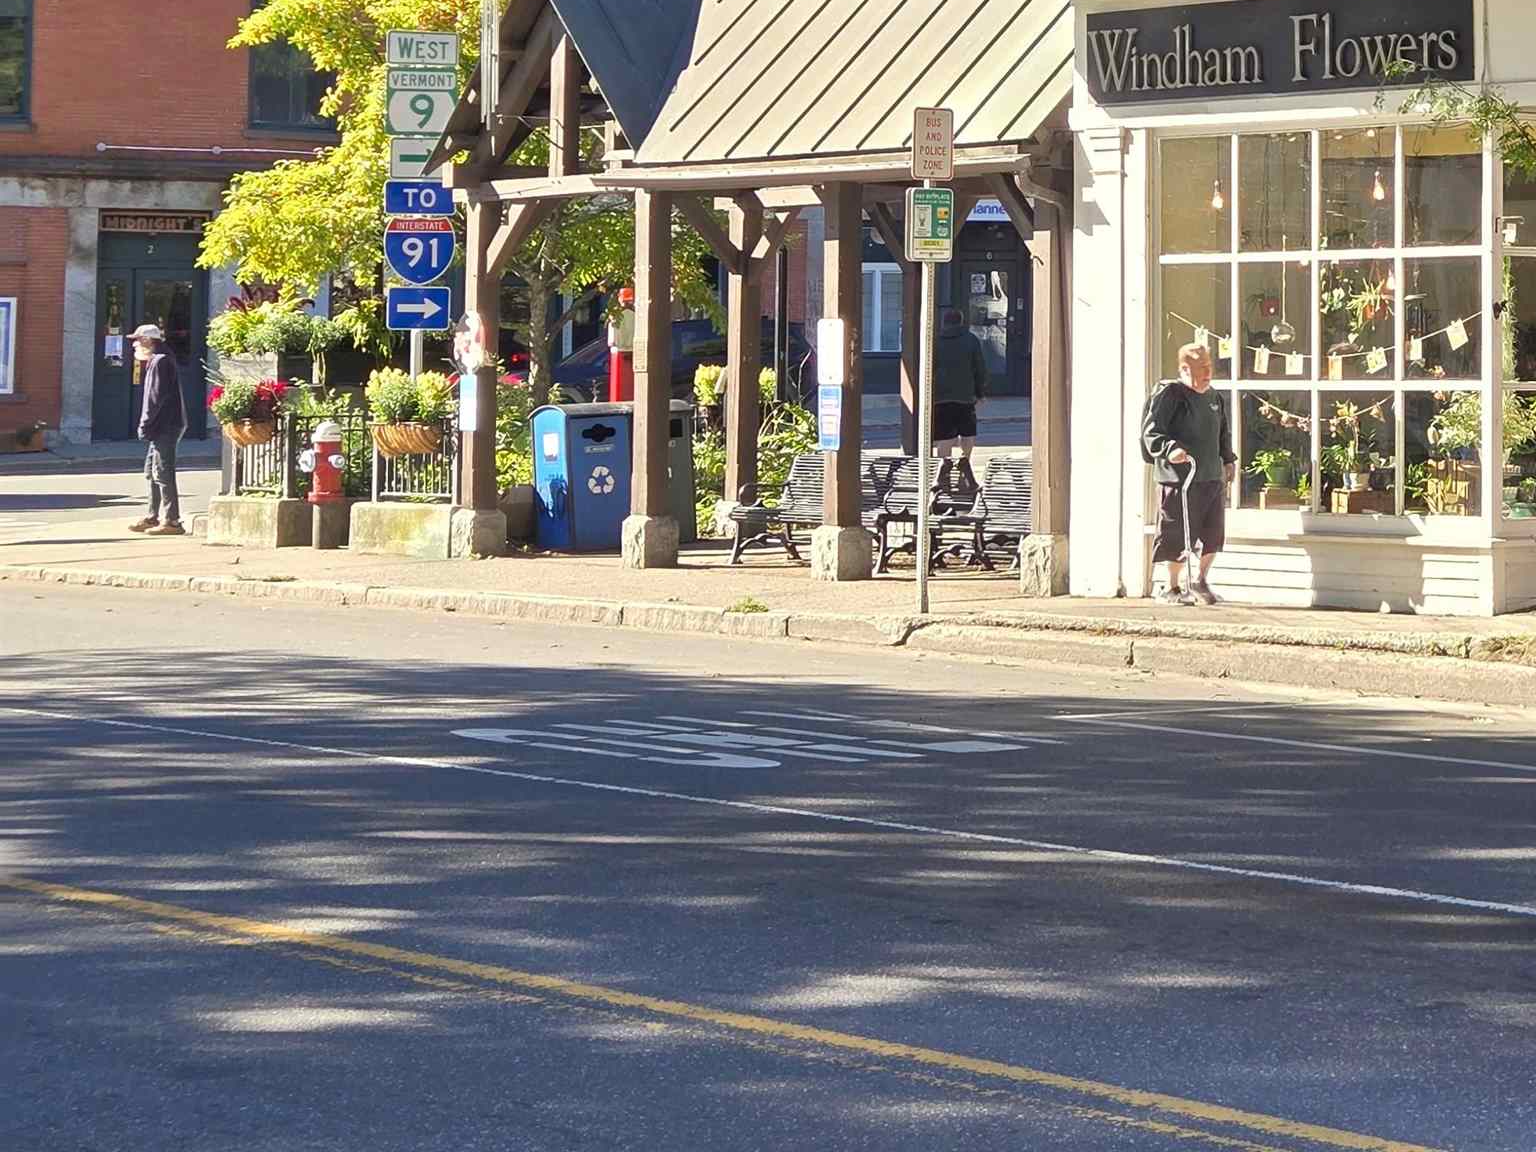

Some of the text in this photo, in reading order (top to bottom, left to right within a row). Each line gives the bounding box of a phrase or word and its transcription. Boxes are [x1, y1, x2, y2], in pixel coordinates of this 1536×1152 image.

[397, 36, 449, 60] WEST
[1087, 11, 1458, 93] Windham Flowers
[391, 73, 454, 87] VERMONT
[409, 93, 434, 128] 9
[926, 118, 943, 128] BUS
[927, 131, 944, 141] AND
[919, 145, 946, 156] POLICE
[923, 159, 944, 170] ZONE
[402, 188, 437, 208] TO
[396, 221, 444, 231] INTERSTATE
[402, 237, 439, 268] 91
